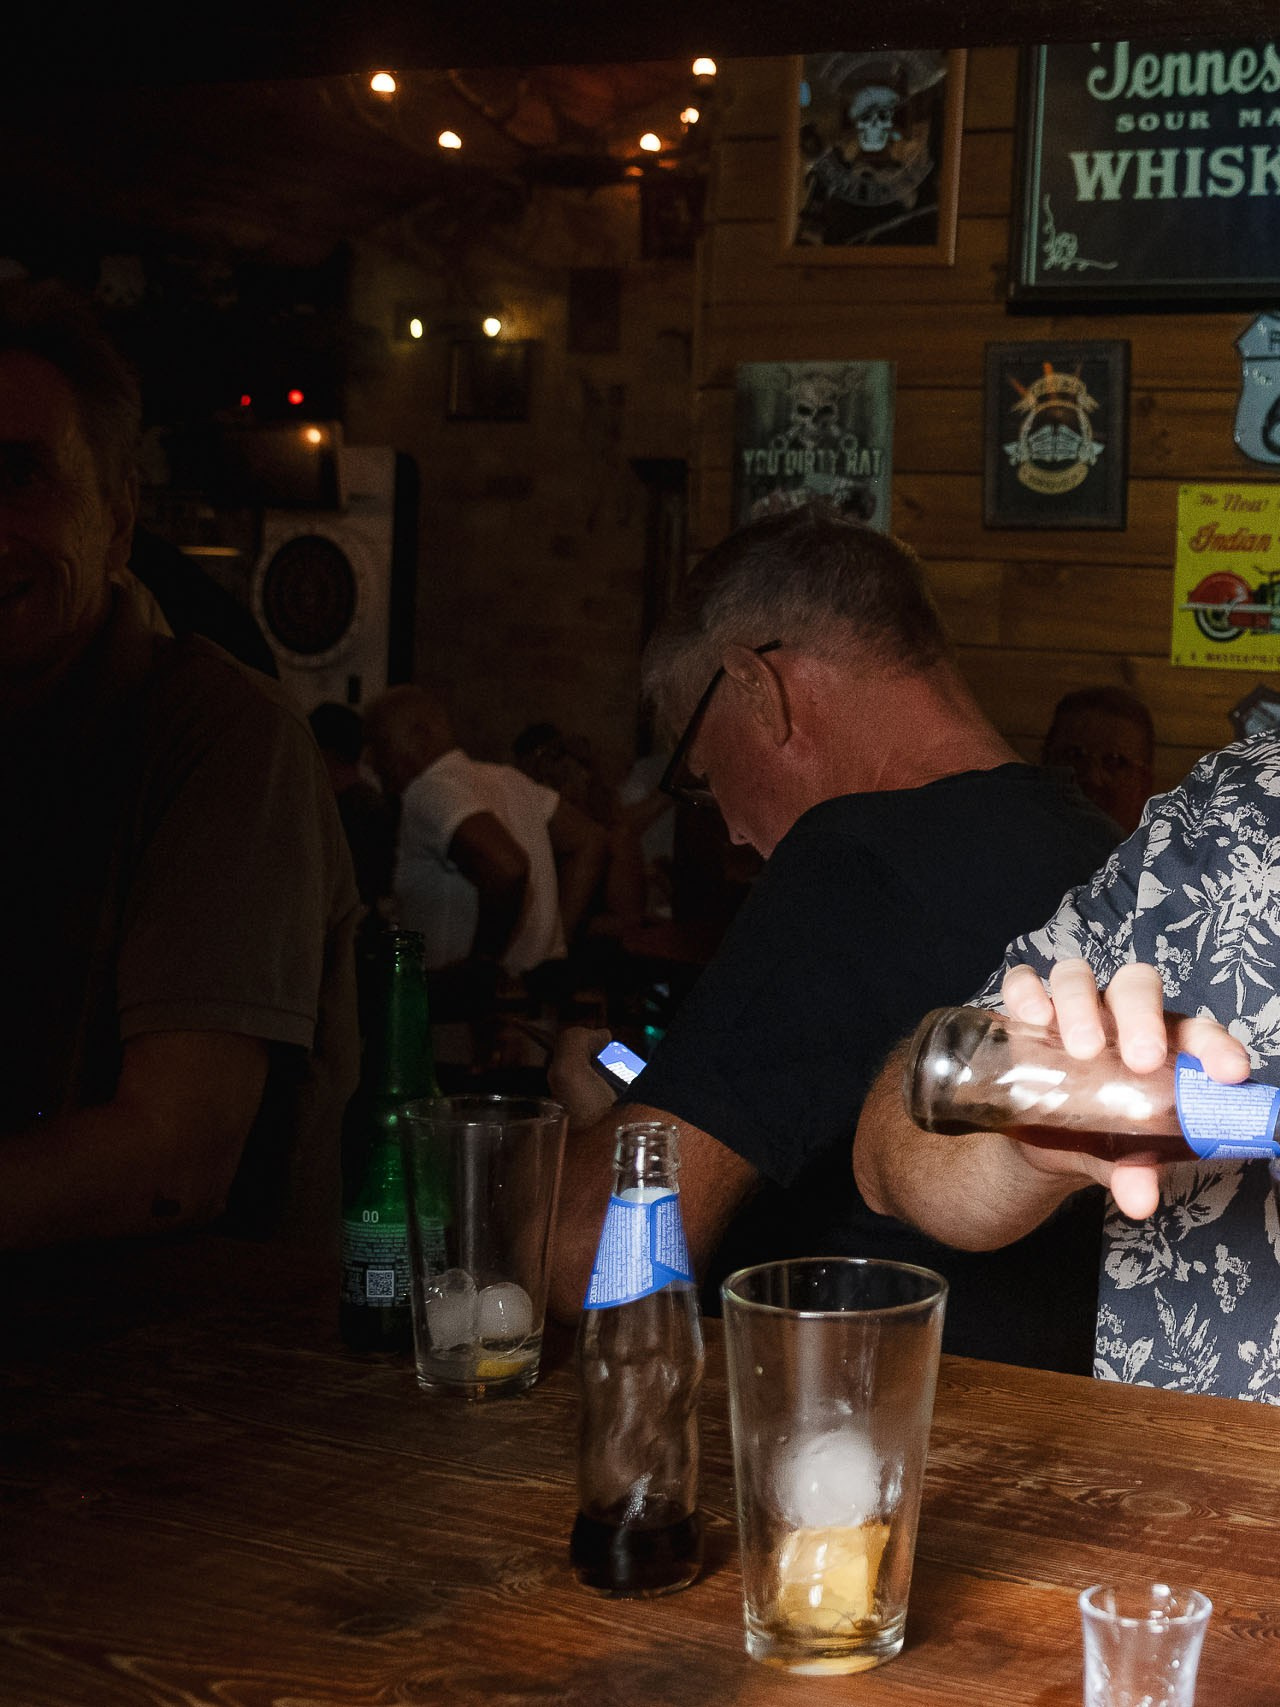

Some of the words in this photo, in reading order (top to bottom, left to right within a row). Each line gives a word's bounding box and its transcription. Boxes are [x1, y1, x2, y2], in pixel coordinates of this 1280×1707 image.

[1115, 110, 1210, 133] SOUR
[743, 450, 778, 475] YOU
[845, 449, 882, 475] RAT
[1189, 521, 1272, 553] Indian
[1179, 1066, 1197, 1080] 200
